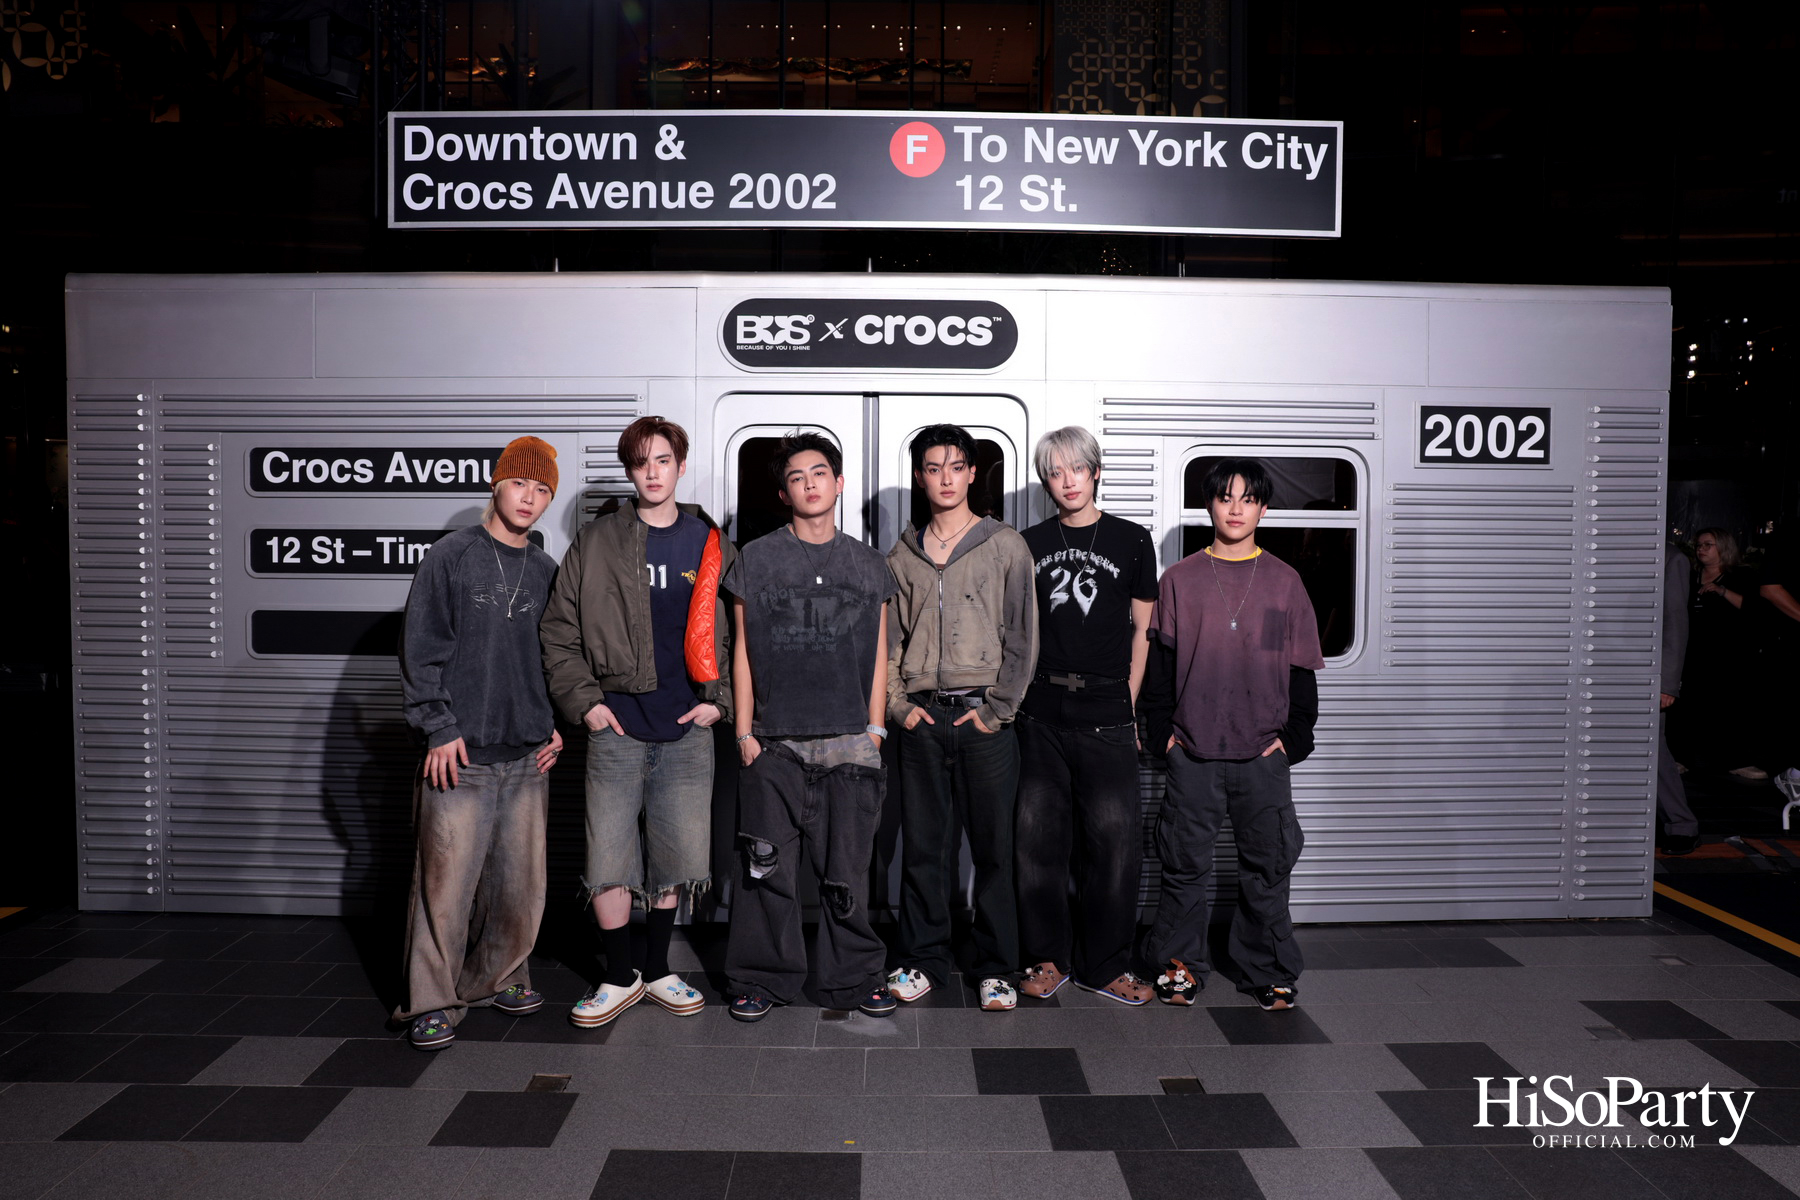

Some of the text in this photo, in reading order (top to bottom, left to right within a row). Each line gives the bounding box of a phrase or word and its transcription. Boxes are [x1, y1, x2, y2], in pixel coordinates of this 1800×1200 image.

[405, 124, 686, 161] Downtown &
[906, 134, 928, 165] F
[953, 126, 1328, 180] To New York City
[403, 173, 836, 210] Crocs Avenue 2002
[955, 174, 1078, 212] 12 St.
[1425, 414, 1544, 458] 2002
[263, 451, 373, 483] Crocs
[267, 537, 300, 563] 12
[312, 536, 344, 563] St
[1050, 565, 1098, 617] 26
